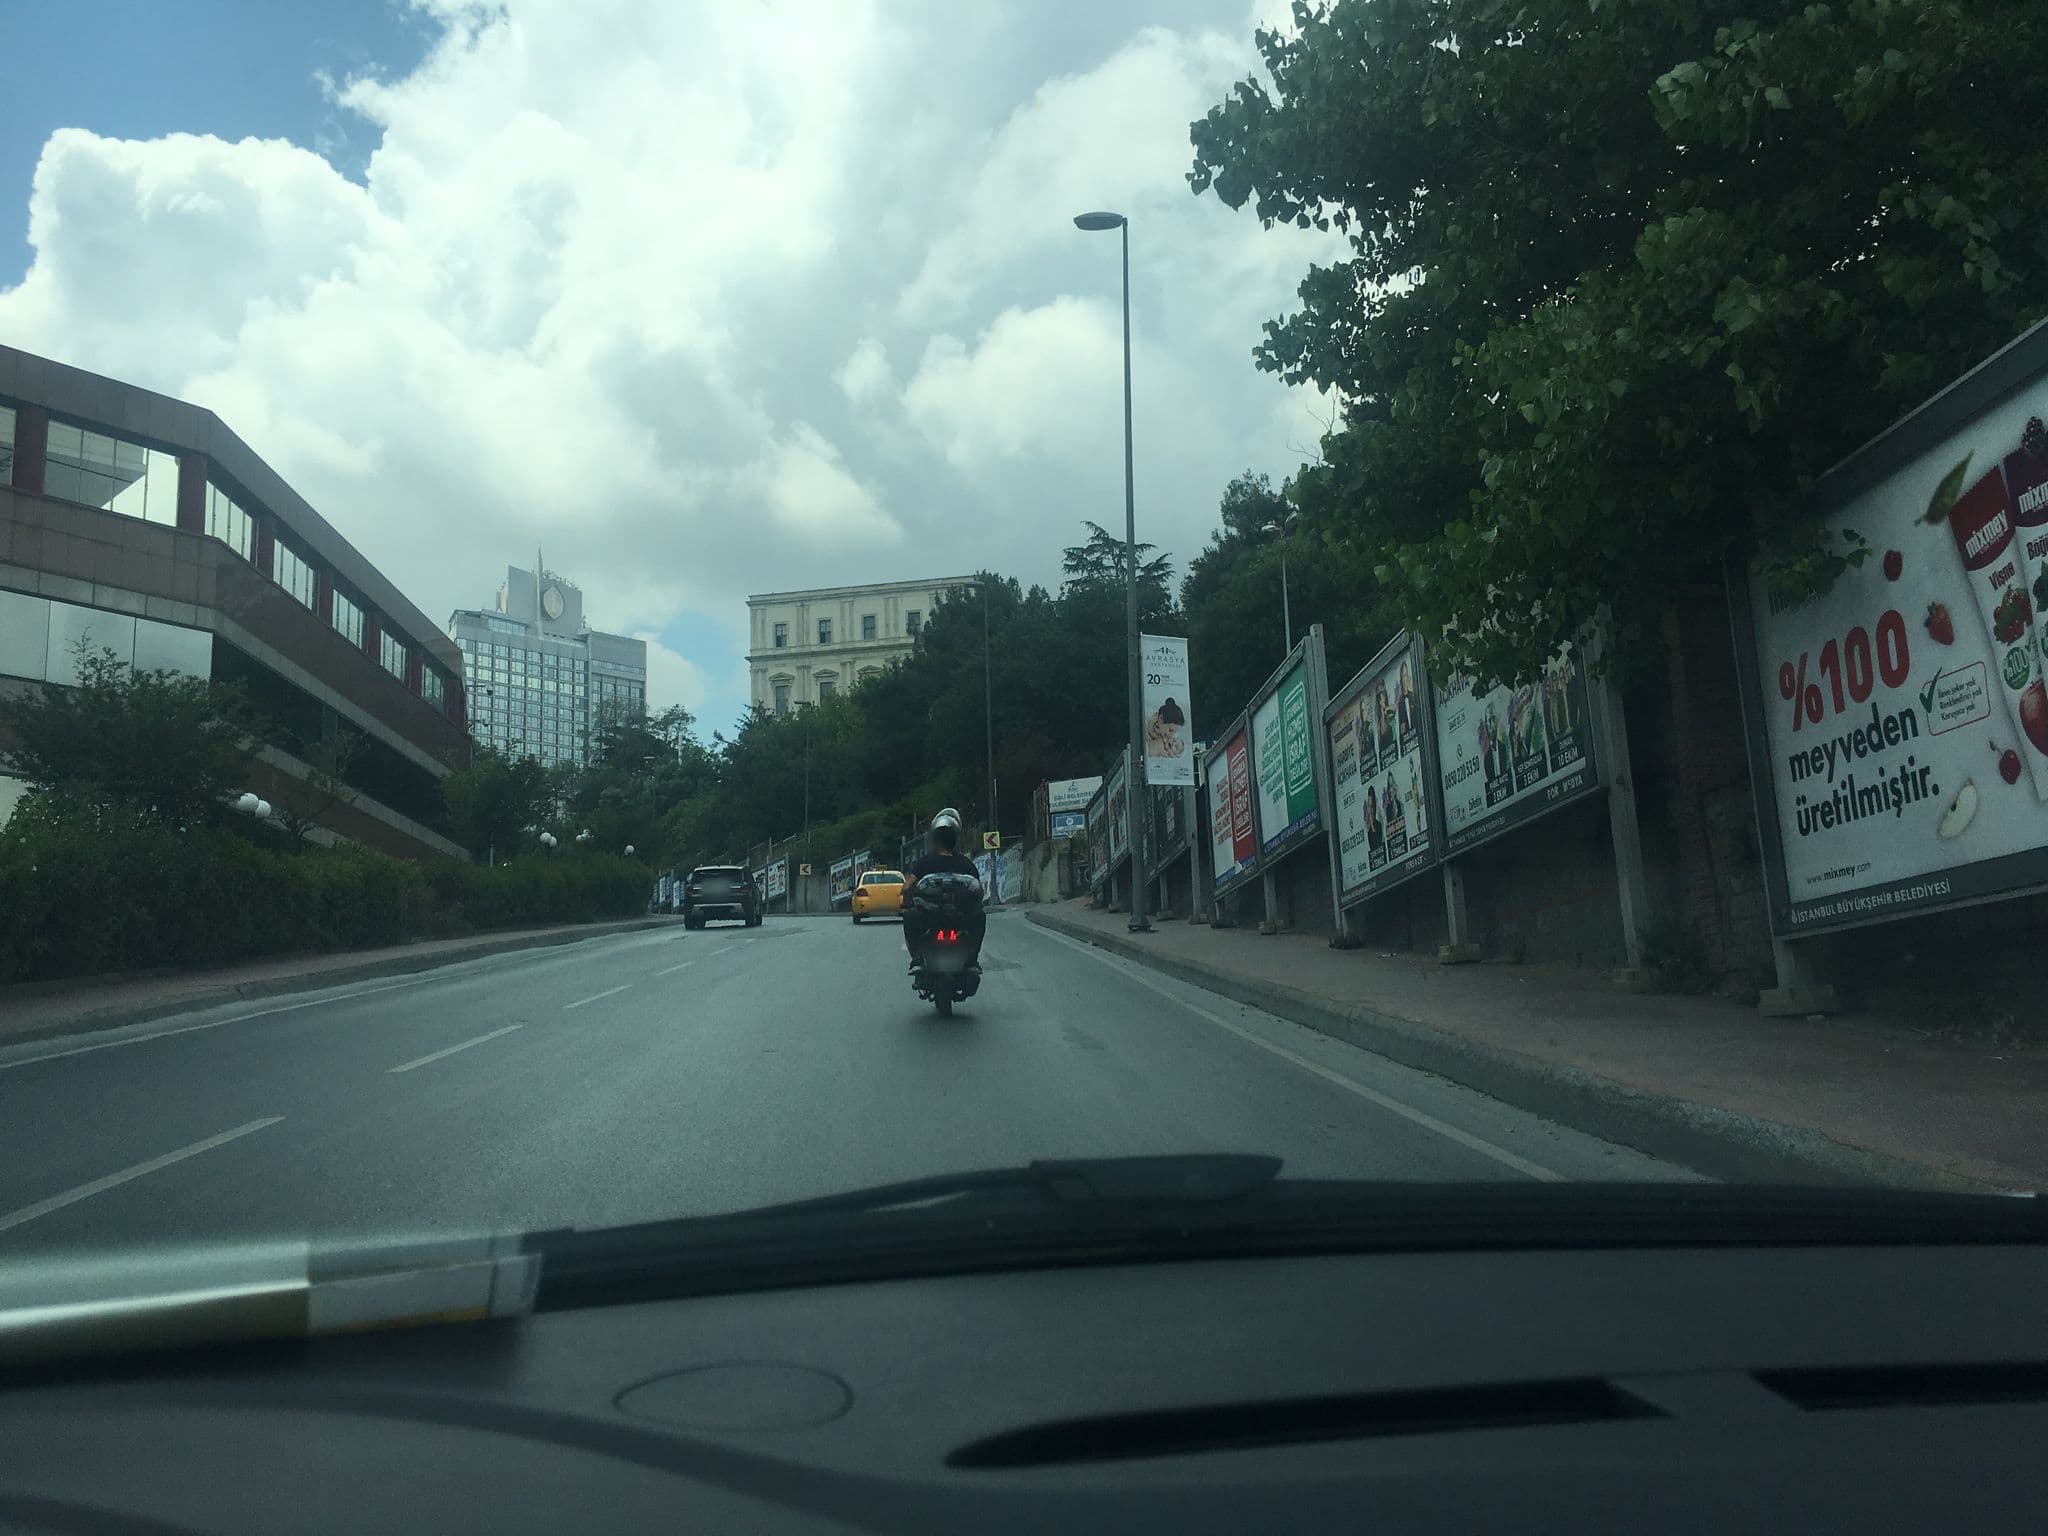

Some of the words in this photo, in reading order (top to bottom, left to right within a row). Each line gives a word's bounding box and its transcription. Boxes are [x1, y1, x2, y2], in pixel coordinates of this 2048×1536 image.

[1966, 509, 2008, 559] mixmey
[1147, 674, 1160, 685] 20
[1779, 609, 1910, 732] %100
[1789, 702, 1918, 783] meyveden
[1796, 755, 1940, 836] üretilmiştir.
[1806, 862, 1871, 884] www.mixmey.com
[1797, 904, 1837, 923] İSTANBUL
[1837, 892, 1893, 914] BÜYÜKŞEHİR
[1894, 878, 1951, 903] BELEDİYESİ
